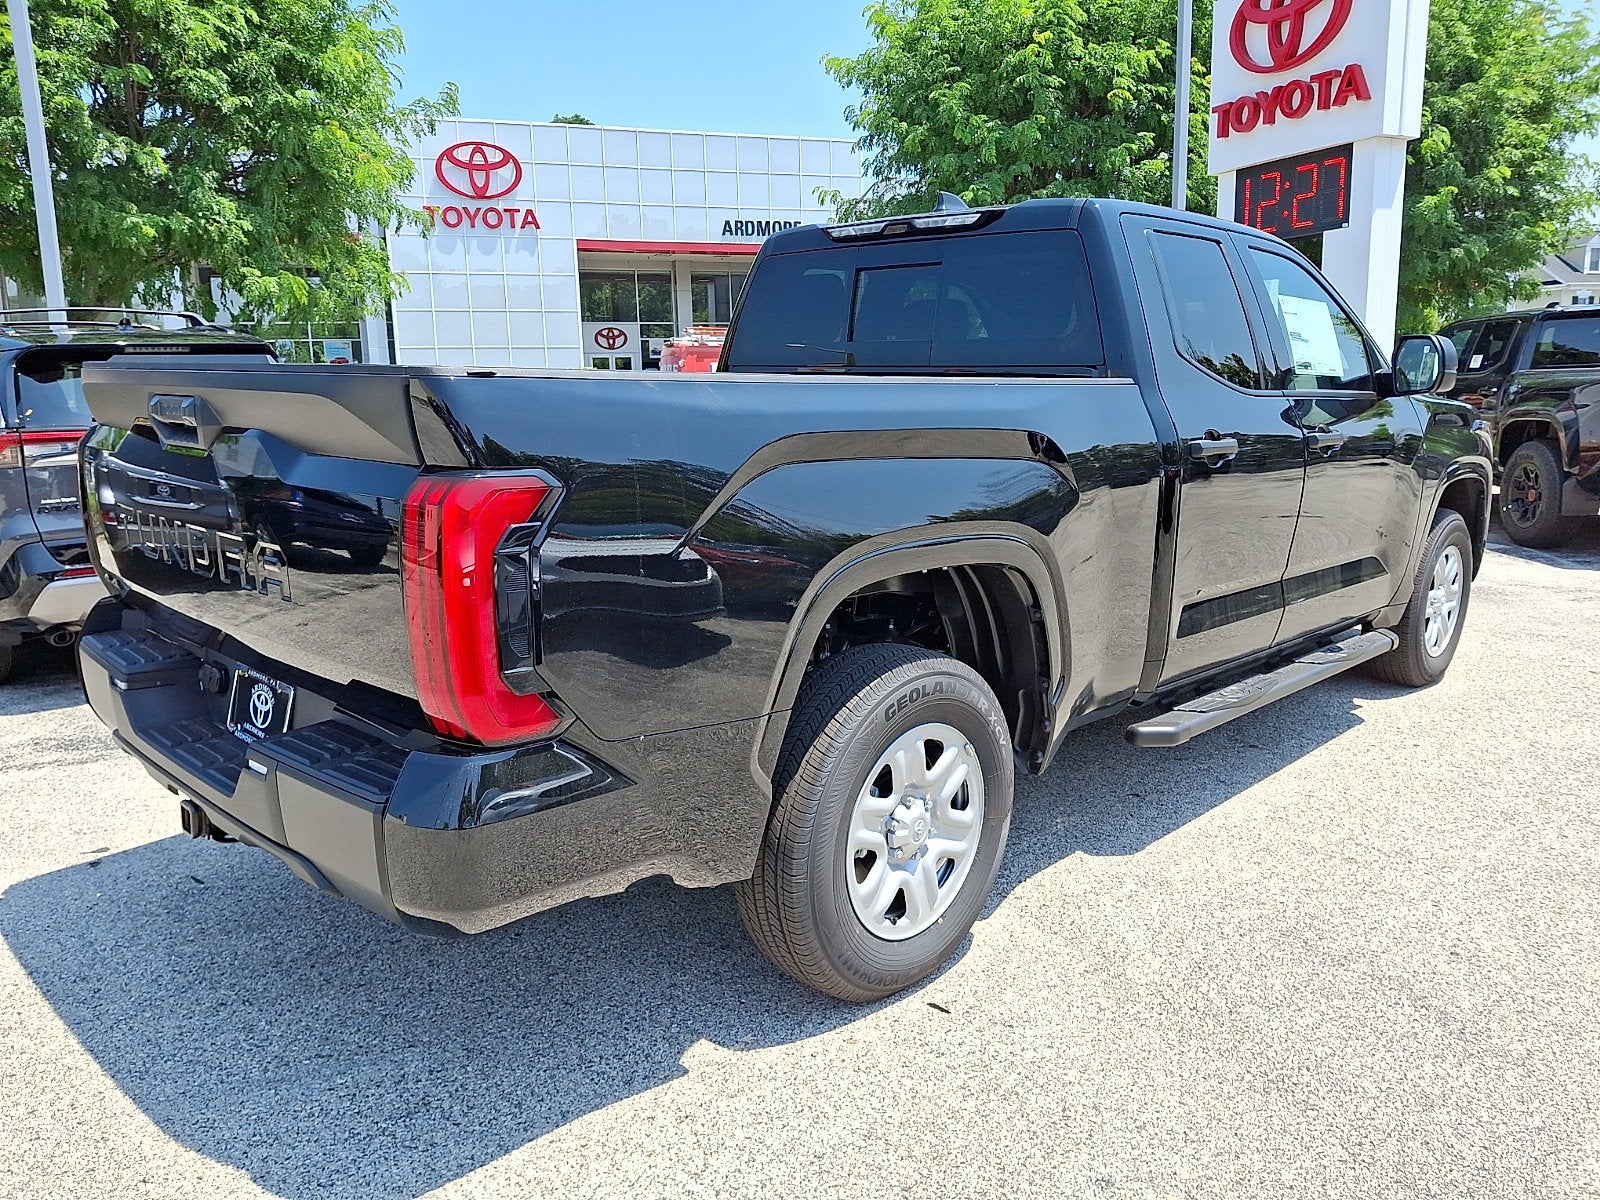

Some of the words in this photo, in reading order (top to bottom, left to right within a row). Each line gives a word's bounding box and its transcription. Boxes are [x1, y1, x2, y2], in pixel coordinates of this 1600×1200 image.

[1212, 63, 1372, 139] TOYOTA
[422, 205, 541, 229] TOYOTA
[1243, 157, 1347, 232] 12:27
[117, 502, 292, 602] TUNDRA
[884, 681, 989, 722] GEOLANDAR
